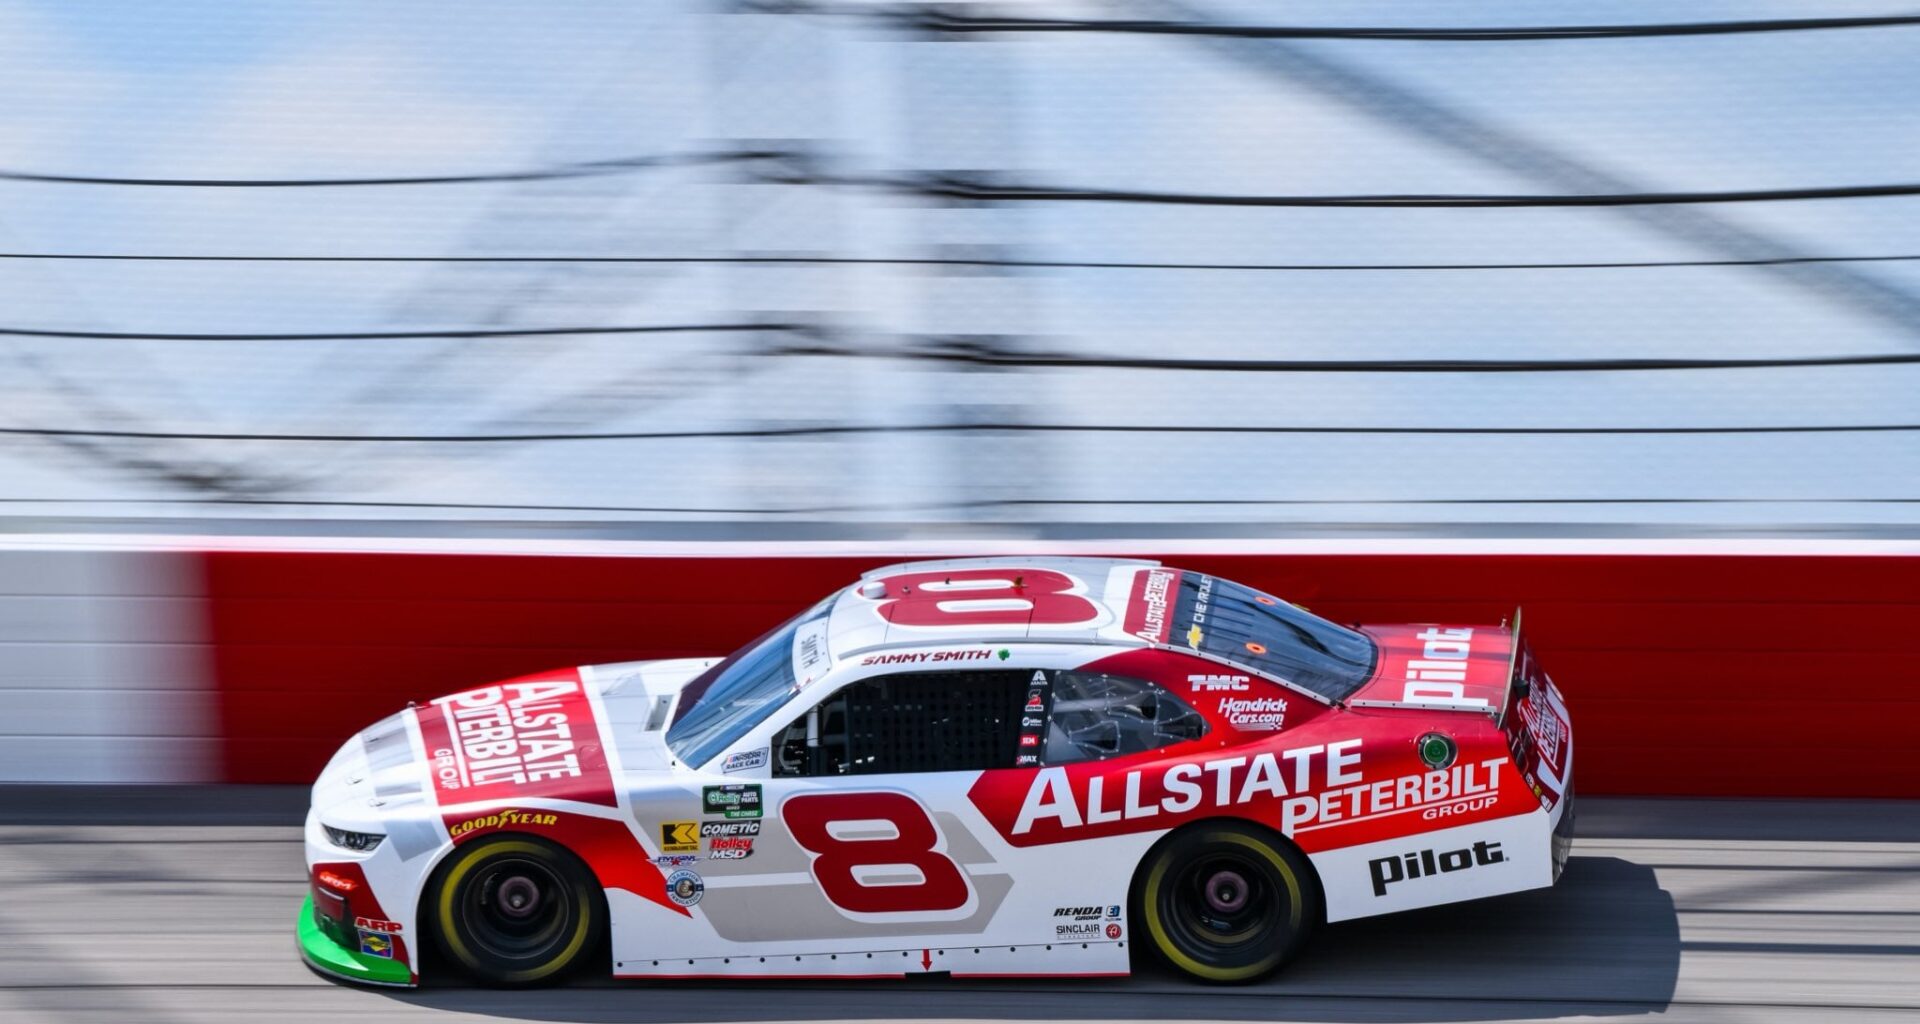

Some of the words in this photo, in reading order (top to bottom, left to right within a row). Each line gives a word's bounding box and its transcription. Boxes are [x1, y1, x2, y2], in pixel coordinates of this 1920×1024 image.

[861, 652, 933, 666] SAMMY
[932, 650, 992, 662] SMITH
[1187, 674, 1250, 692] TMC
[1218, 697, 1288, 718] Hendrick
[1229, 712, 1285, 724] Cars.com
[501, 681, 583, 782] ALLSTATE
[726, 761, 744, 770] RACE
[745, 758, 761, 767] CAR
[1011, 738, 1363, 836] ALLSTATE
[1281, 757, 1508, 840] PETERBILT
[1422, 797, 1498, 820] GROUP
[450, 809, 558, 836] GOODYEAR
[709, 837, 753, 851] Holley
[782, 792, 969, 913] 8
[710, 849, 747, 859] MSD
[1053, 906, 1103, 917] RENDA
[355, 917, 403, 933] ARP
[1056, 924, 1101, 934] SINCLAIR
